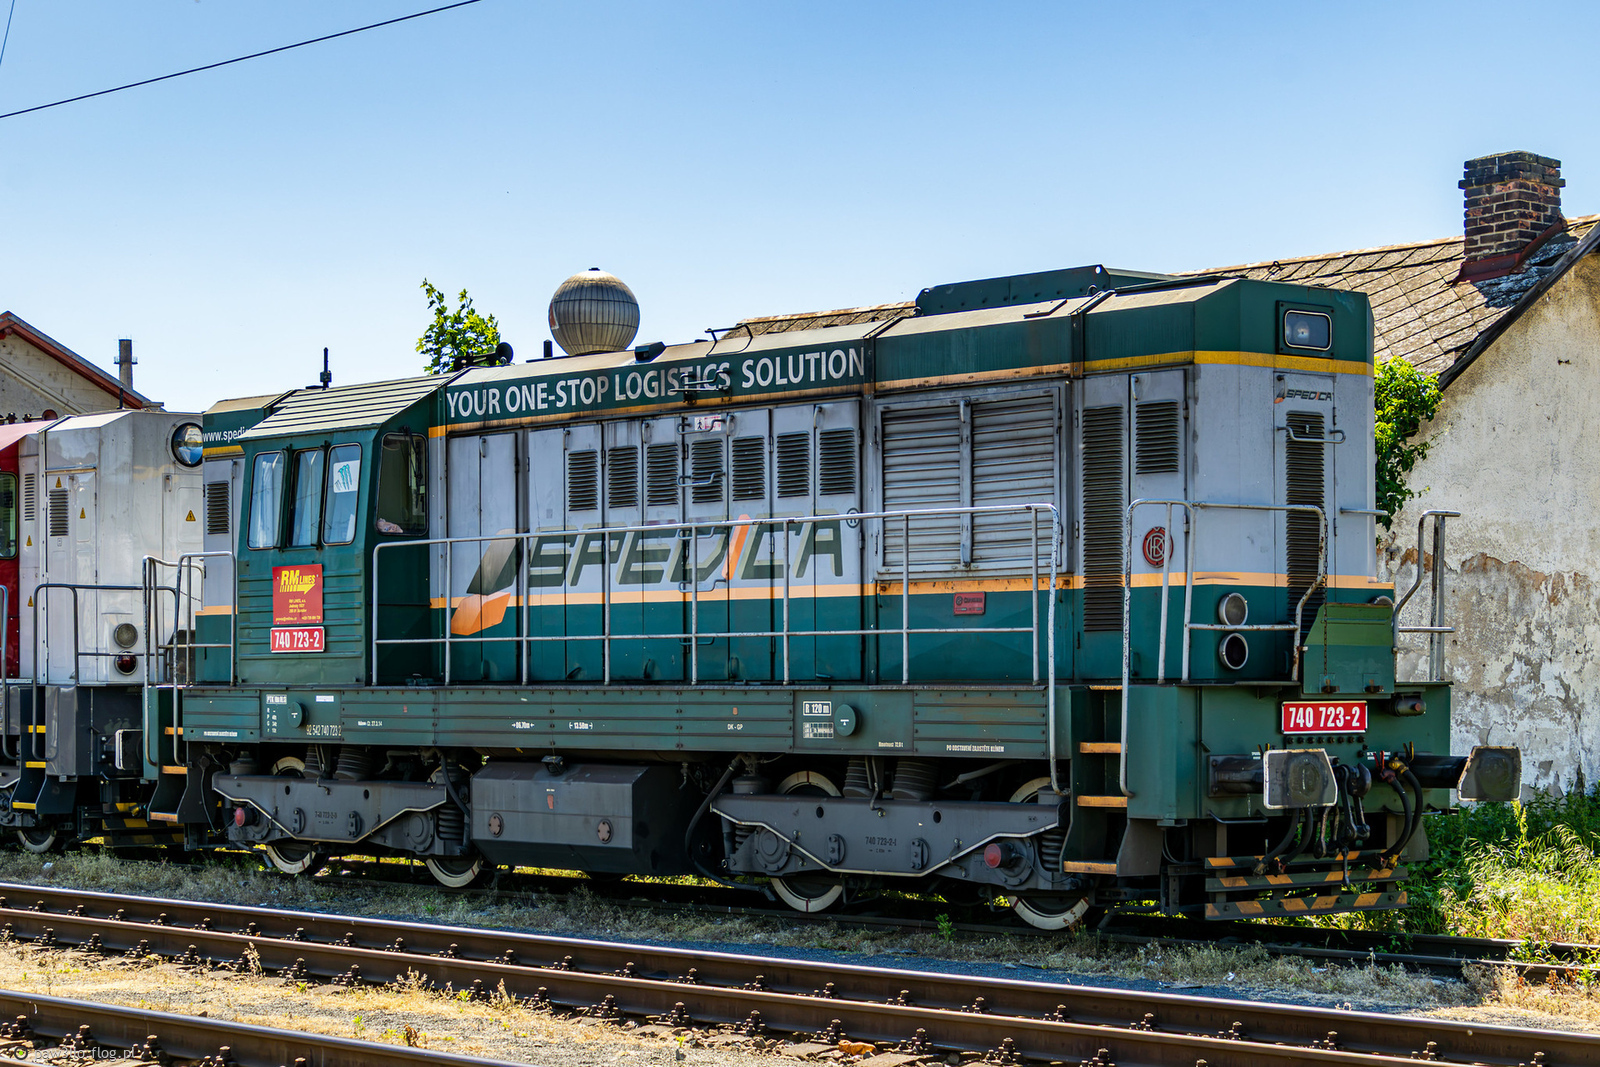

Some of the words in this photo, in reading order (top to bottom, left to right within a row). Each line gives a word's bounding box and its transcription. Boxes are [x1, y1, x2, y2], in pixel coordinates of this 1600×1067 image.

[446, 388, 500, 418] YOUR
[505, 376, 609, 412] ONE-STOP
[614, 362, 731, 400] LOGISTICS
[741, 347, 865, 388] SOLUTION
[1286, 389, 1332, 401] SPEDICA
[203, 426, 249, 443] www.spedi
[281, 570, 300, 585] RM
[300, 575, 316, 584] LINES
[275, 631, 290, 648] 740
[293, 631, 320, 648] 723-2
[805, 703, 810, 713] R
[812, 703, 822, 713] 120
[823, 705, 830, 713] m
[1289, 707, 1314, 728] 740
[1319, 706, 1360, 727] 723-2
